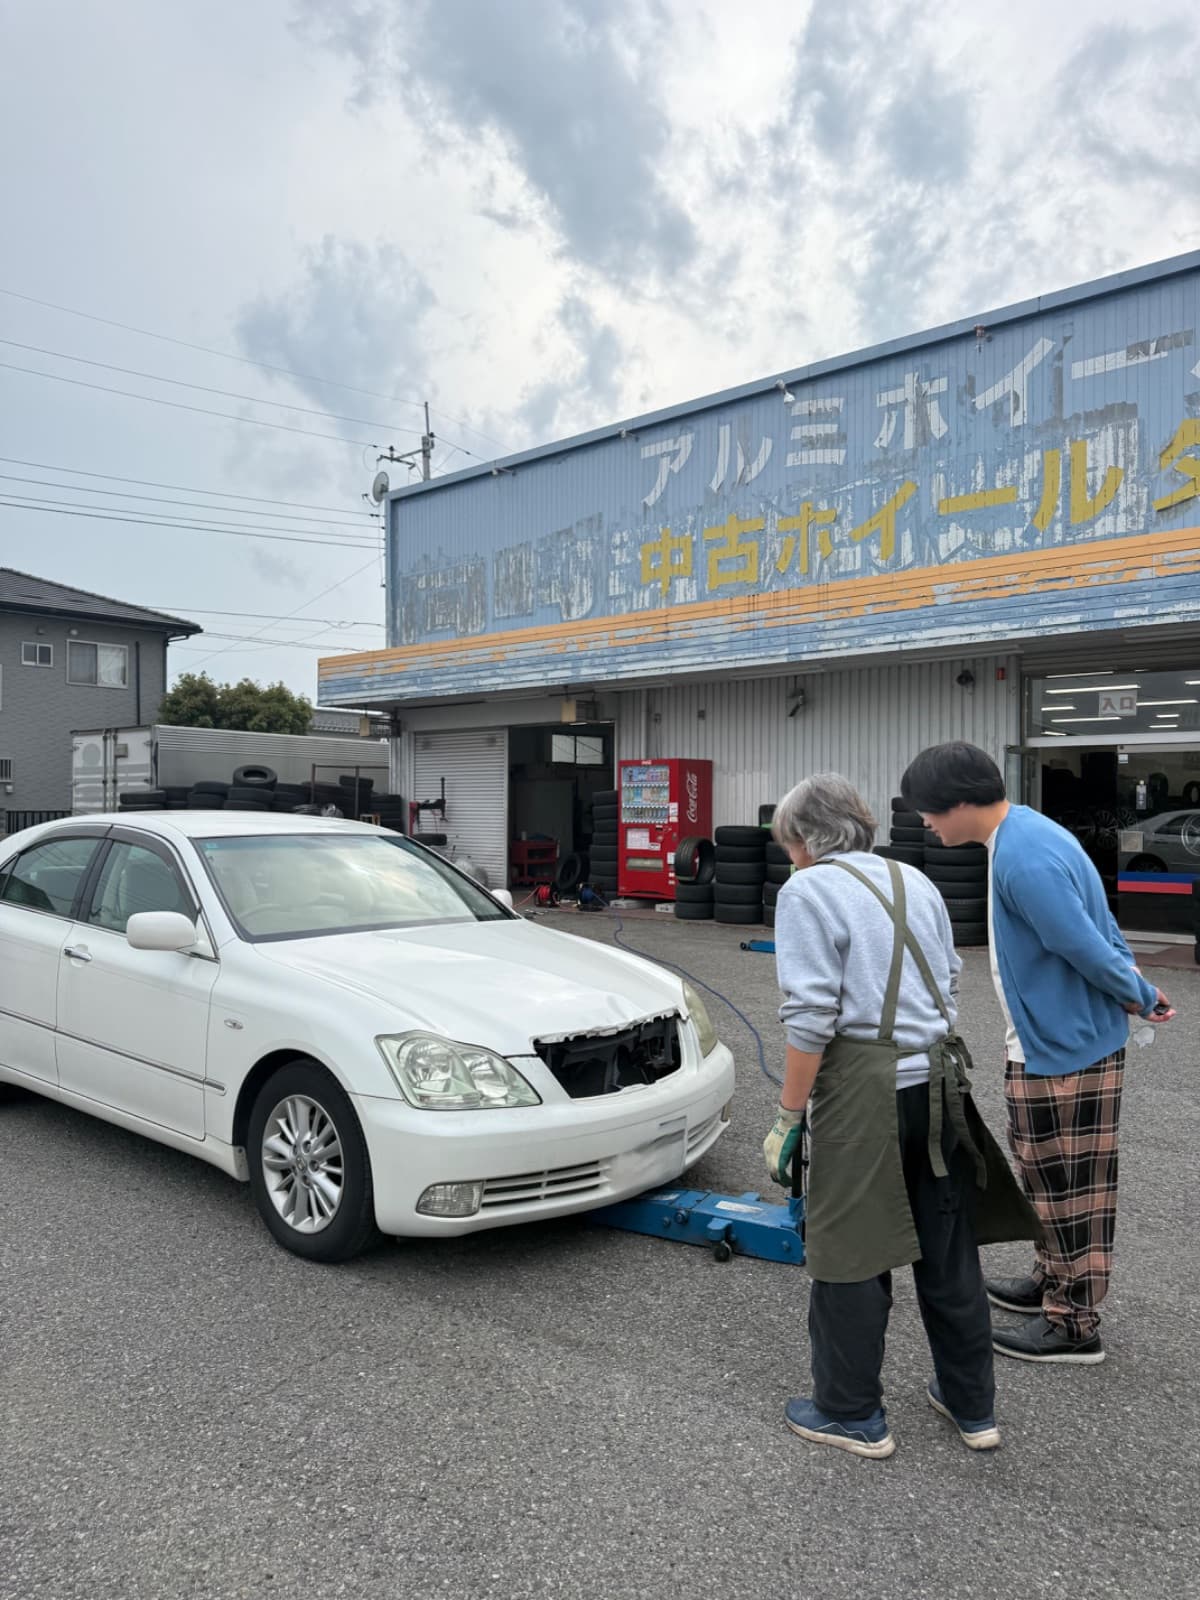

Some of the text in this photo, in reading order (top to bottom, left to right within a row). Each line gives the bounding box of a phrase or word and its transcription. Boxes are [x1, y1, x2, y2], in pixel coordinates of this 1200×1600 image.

[641, 336, 1200, 506] アルミホイー
[1102, 697, 1136, 711] 入口
